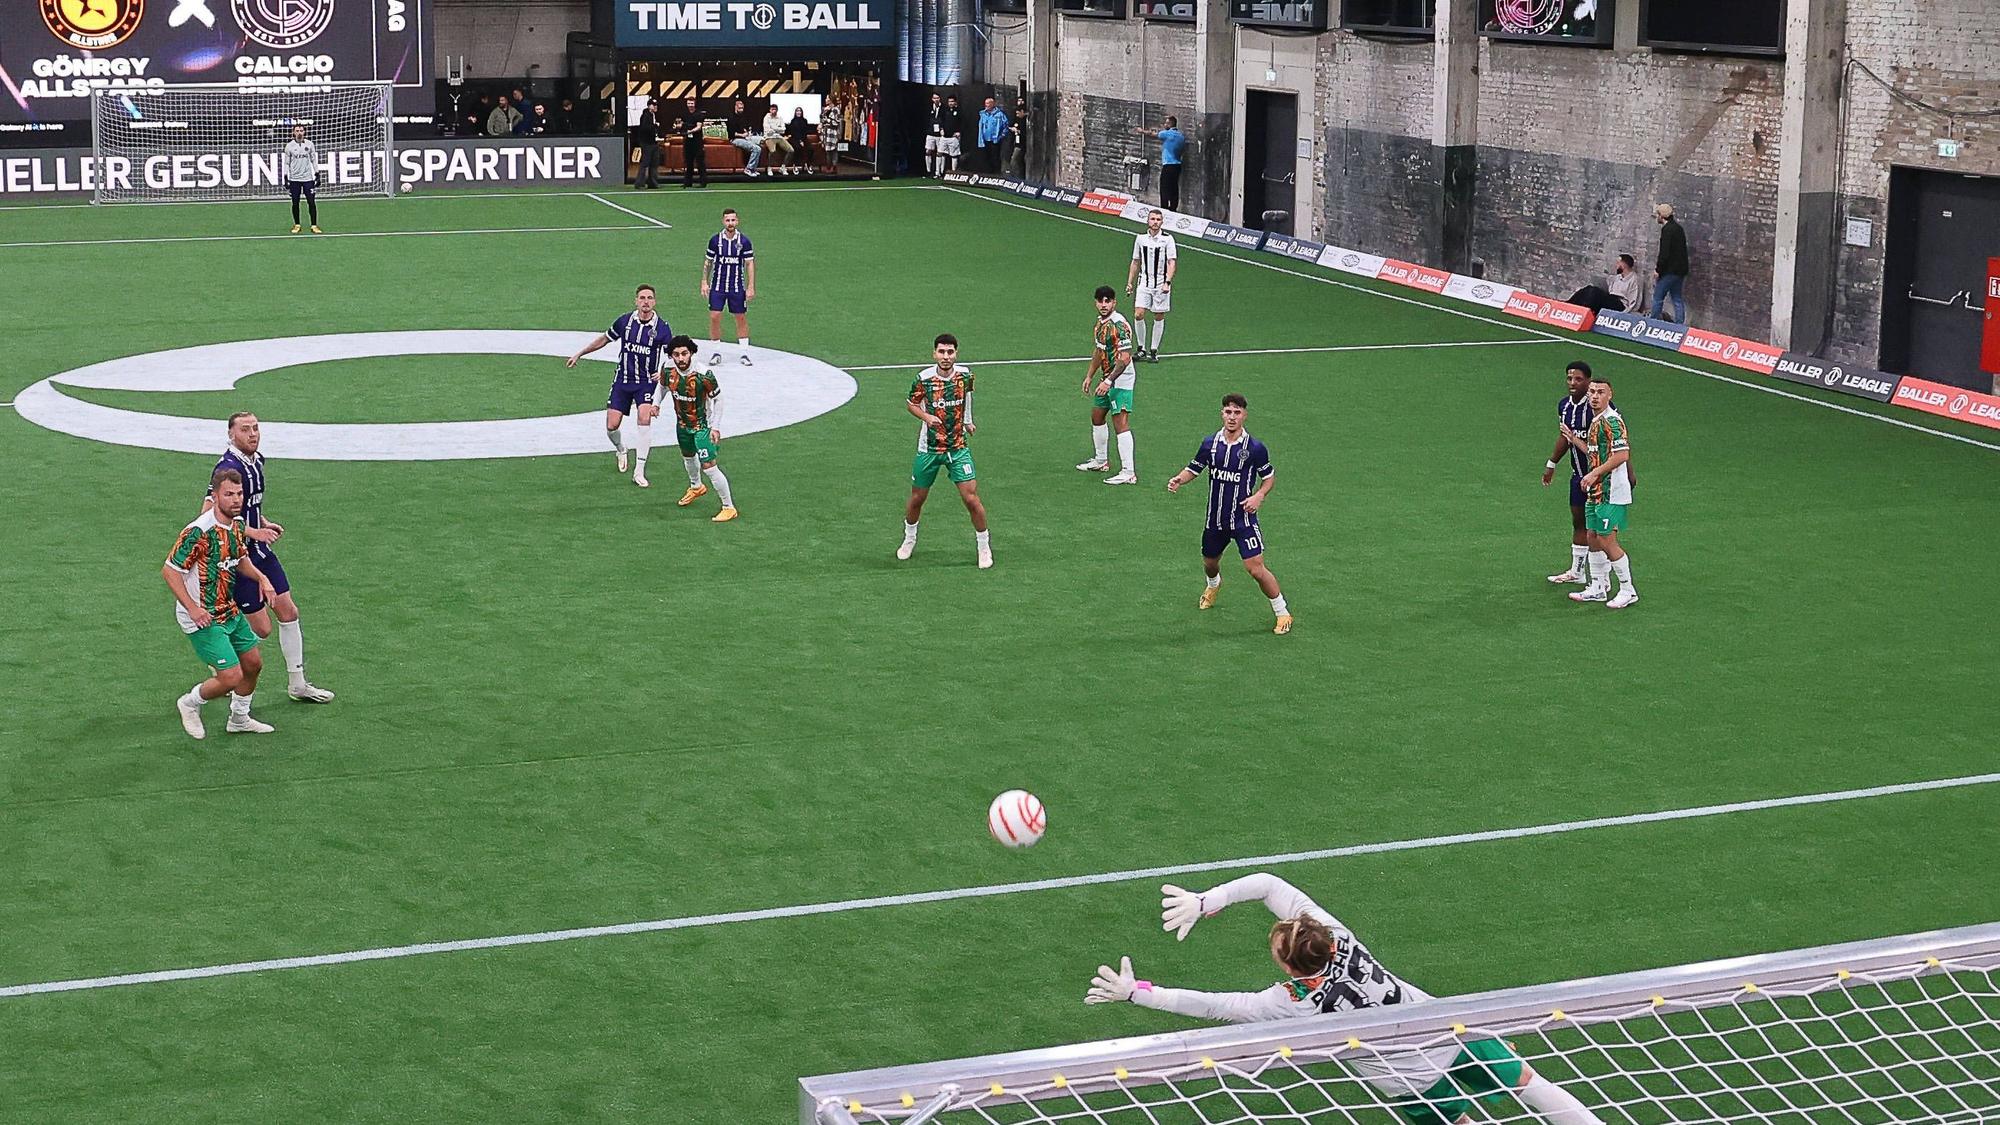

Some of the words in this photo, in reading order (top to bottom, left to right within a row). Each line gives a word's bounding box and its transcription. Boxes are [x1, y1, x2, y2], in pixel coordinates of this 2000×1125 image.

[630, 3, 720, 30] TIME
[784, 3, 880, 30] BALL
[32, 54, 150, 77] GÖNRGY
[234, 54, 334, 74] CALCIO
[1206, 226, 1227, 239] BALLER
[1234, 232, 1260, 246] LEAGUE
[1265, 237, 1289, 251] BALLER
[1295, 245, 1320, 259] LEAGUE
[1381, 264, 1408, 279] BALLER
[1417, 273, 1446, 289] LEAGUE
[1507, 297, 1539, 314] BALLER
[1549, 309, 1584, 326] LEAGUE
[1594, 315, 1631, 333] BALLER
[1645, 326, 1684, 344] LEAGUE
[631, 344, 652, 356] XING
[1684, 335, 1723, 354] BALLER
[1737, 349, 1778, 368] LEAGUE
[1776, 359, 1823, 380] BALLER
[1841, 374, 1893, 396] LEAGUE
[1897, 386, 1948, 407] BALLER
[1216, 468, 1241, 483] XING
[1602, 518, 1610, 530] 7
[1244, 536, 1259, 550] 10
